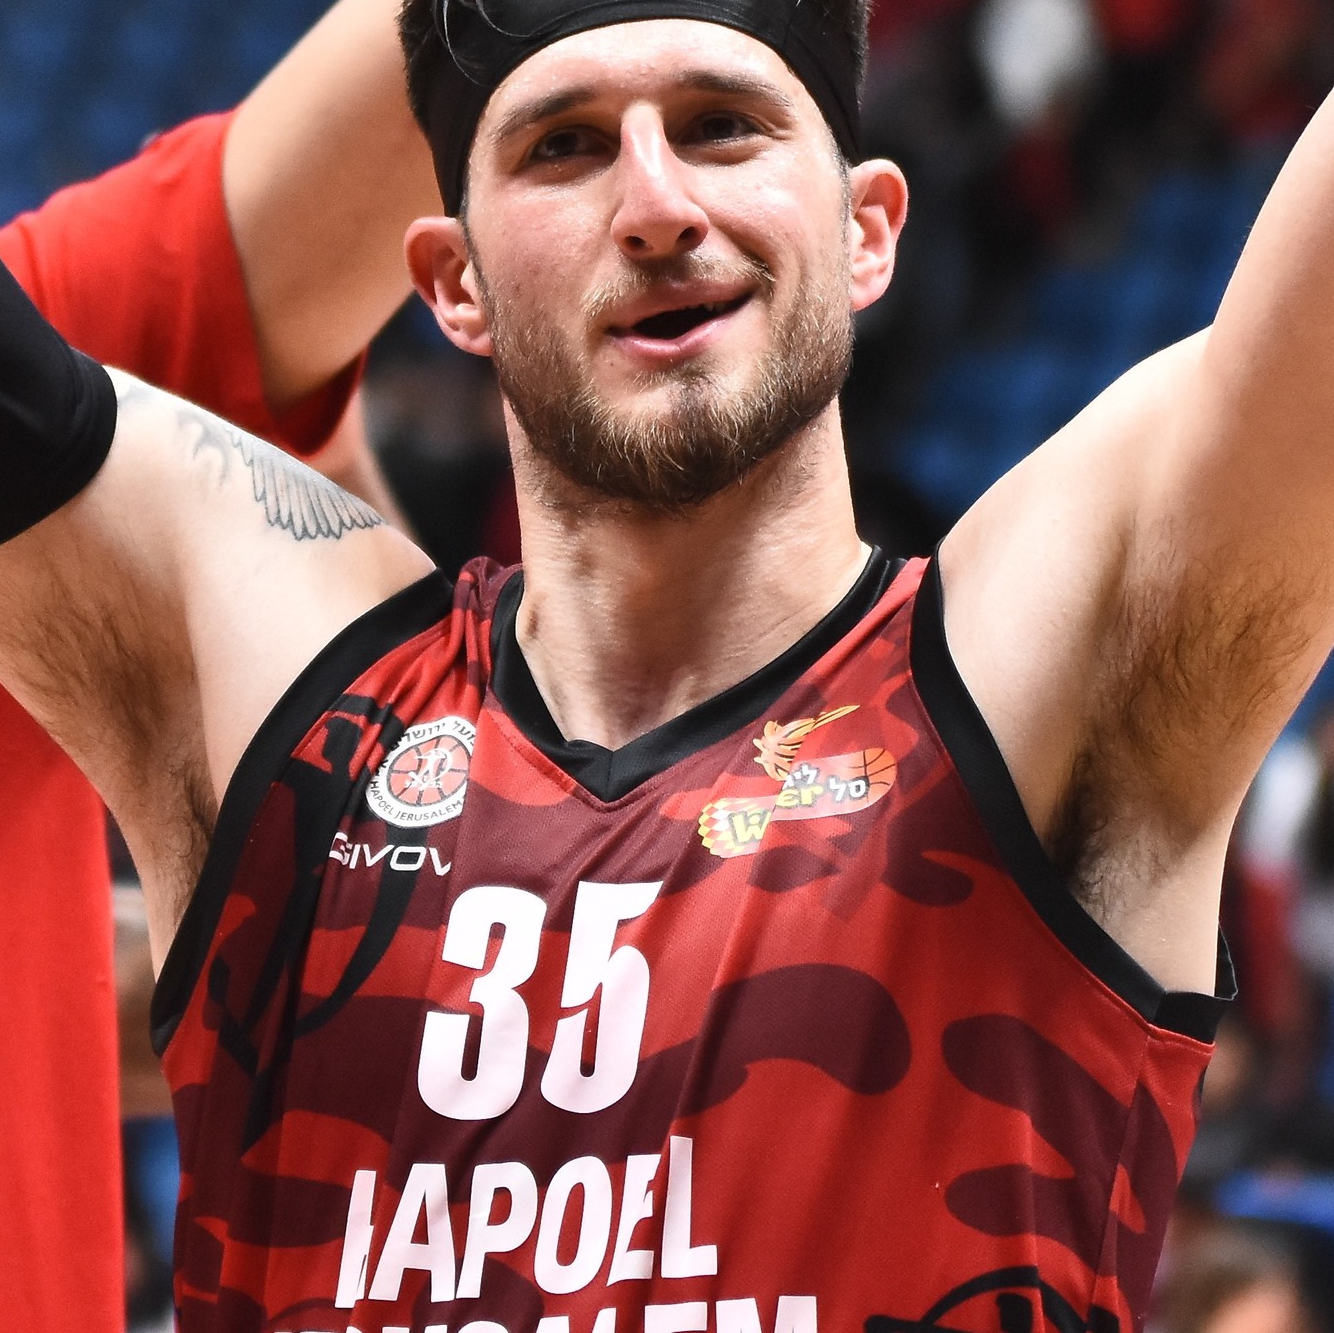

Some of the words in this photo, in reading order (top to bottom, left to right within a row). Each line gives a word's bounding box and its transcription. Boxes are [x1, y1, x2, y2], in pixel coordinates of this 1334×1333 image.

[370, 781, 395, 816] HAPOEL
[393, 799, 463, 822] JERUSALEM
[415, 880, 665, 1122] 35
